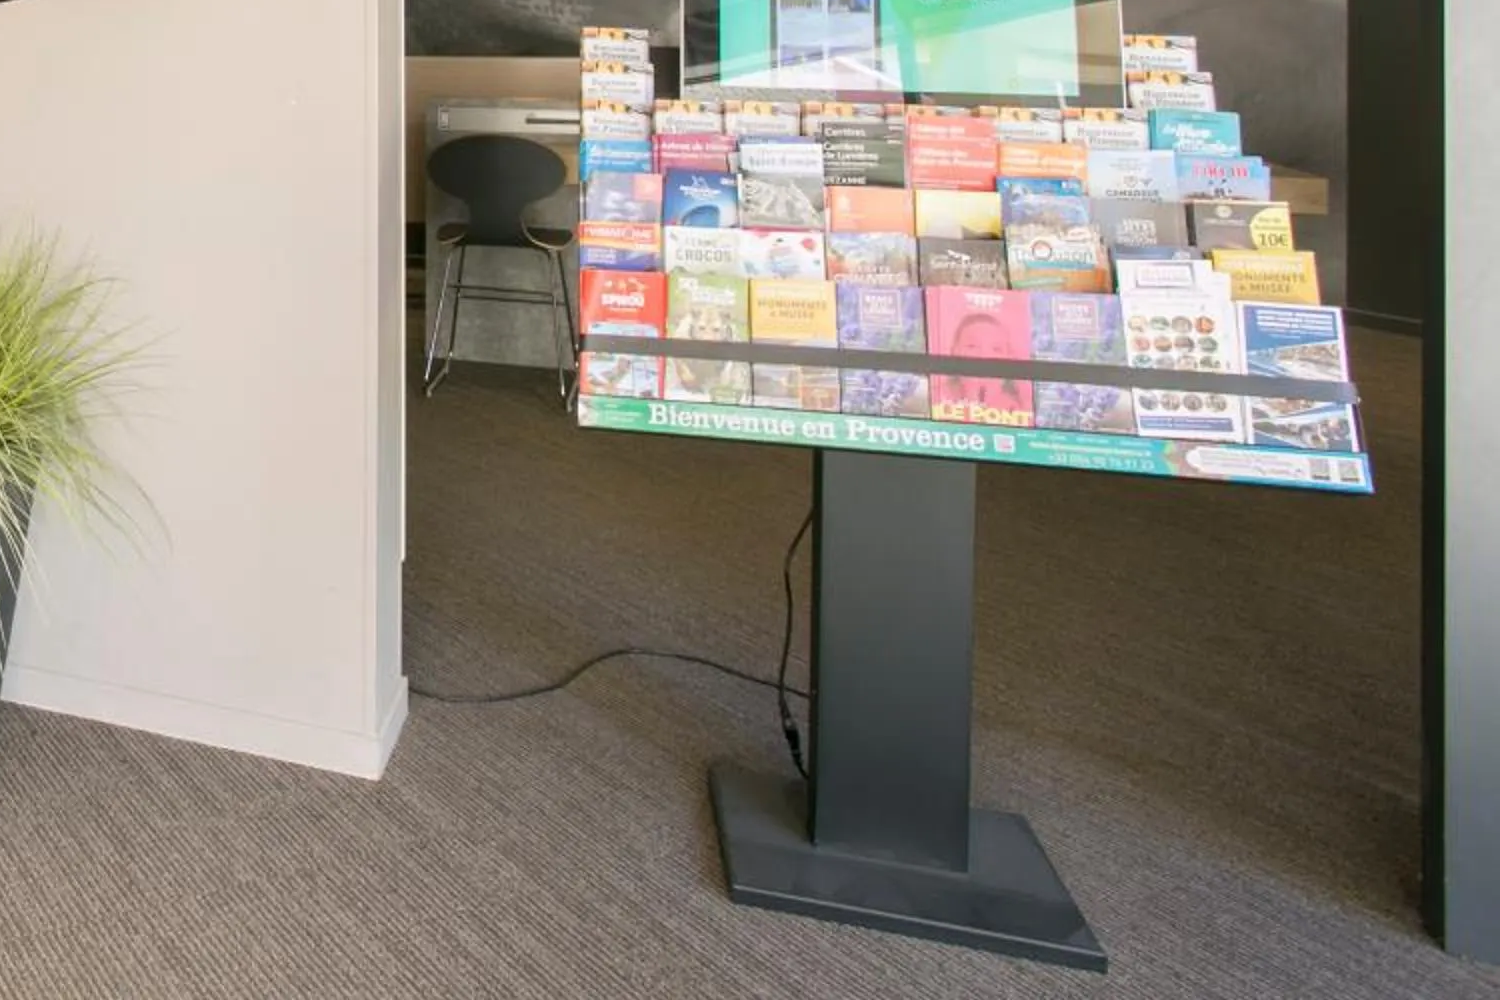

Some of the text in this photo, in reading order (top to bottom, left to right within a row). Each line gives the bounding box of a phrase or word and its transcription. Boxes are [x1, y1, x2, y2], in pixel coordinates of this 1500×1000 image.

[647, 403, 796, 437] Bienvenue
[802, 419, 836, 440] en
[845, 418, 986, 451] Provence
